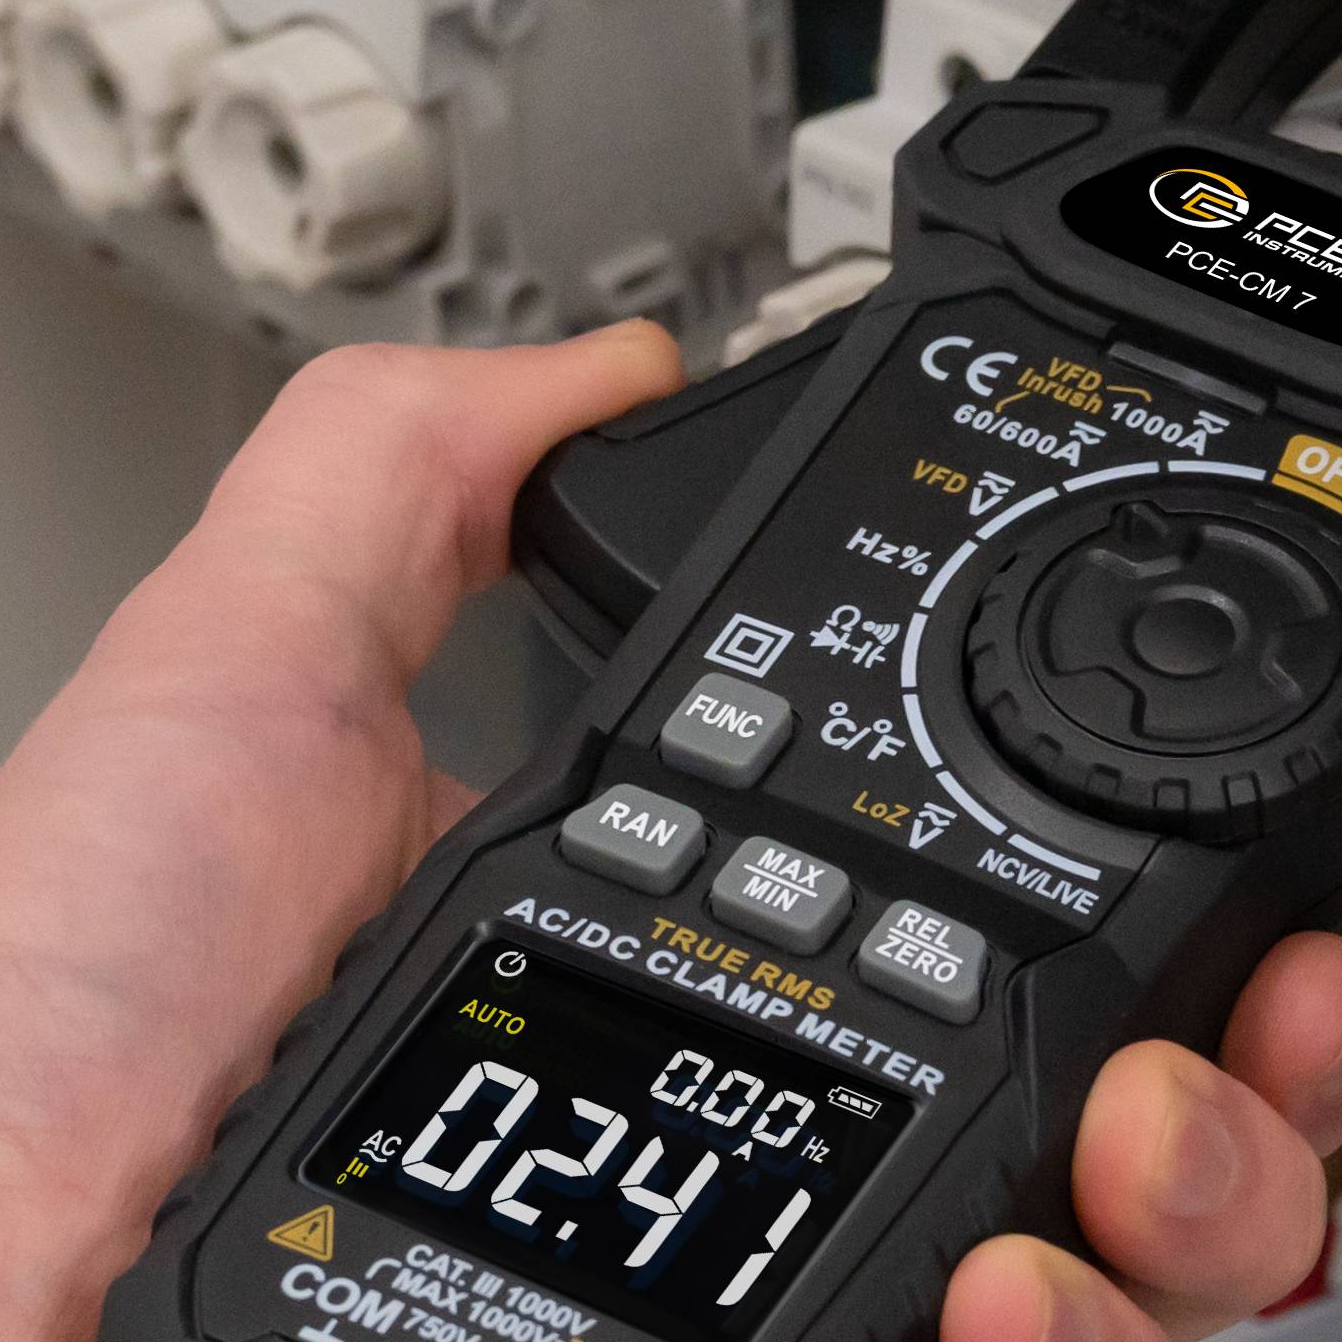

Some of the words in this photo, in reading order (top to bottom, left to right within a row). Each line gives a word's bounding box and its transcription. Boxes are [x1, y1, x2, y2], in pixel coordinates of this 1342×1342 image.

[1165, 241, 1292, 303] PCE-CM
[1292, 291, 1318, 311] 7
[920, 335, 1019, 397] CE
[1048, 356, 1103, 392] VFD
[1016, 367, 1104, 414] Inrush
[912, 458, 969, 494] VFD
[845, 526, 933, 576] Hz%
[685, 693, 764, 739] FUNC
[598, 800, 680, 848] RAN
[851, 790, 912, 828] LoZ
[757, 847, 826, 890] MAX
[976, 847, 1100, 917] NCV/LIVE
[742, 874, 802, 913] MIN
[894, 907, 951, 950] REL
[651, 916, 751, 974] TRUE
[750, 960, 837, 1010] RMS
[873, 936, 958, 985] ZERO
[459, 998, 527, 1036] AUTO
[503, 897, 642, 962] AC/DC
[644, 949, 794, 1021] CLAMP
[795, 1011, 946, 1096] METER
[650, 1049, 816, 1149] 0.00
[801, 1135, 831, 1164] Hz
[361, 1129, 402, 1157] AC
[732, 1141, 755, 1161] A
[401, 1060, 812, 1307] 02.41
[280, 1263, 406, 1335] COM
[391, 1267, 470, 1315] MAX
[405, 1244, 473, 1285] CAT.
[472, 1270, 504, 1298] III
[505, 1285, 598, 1338] 1000V
